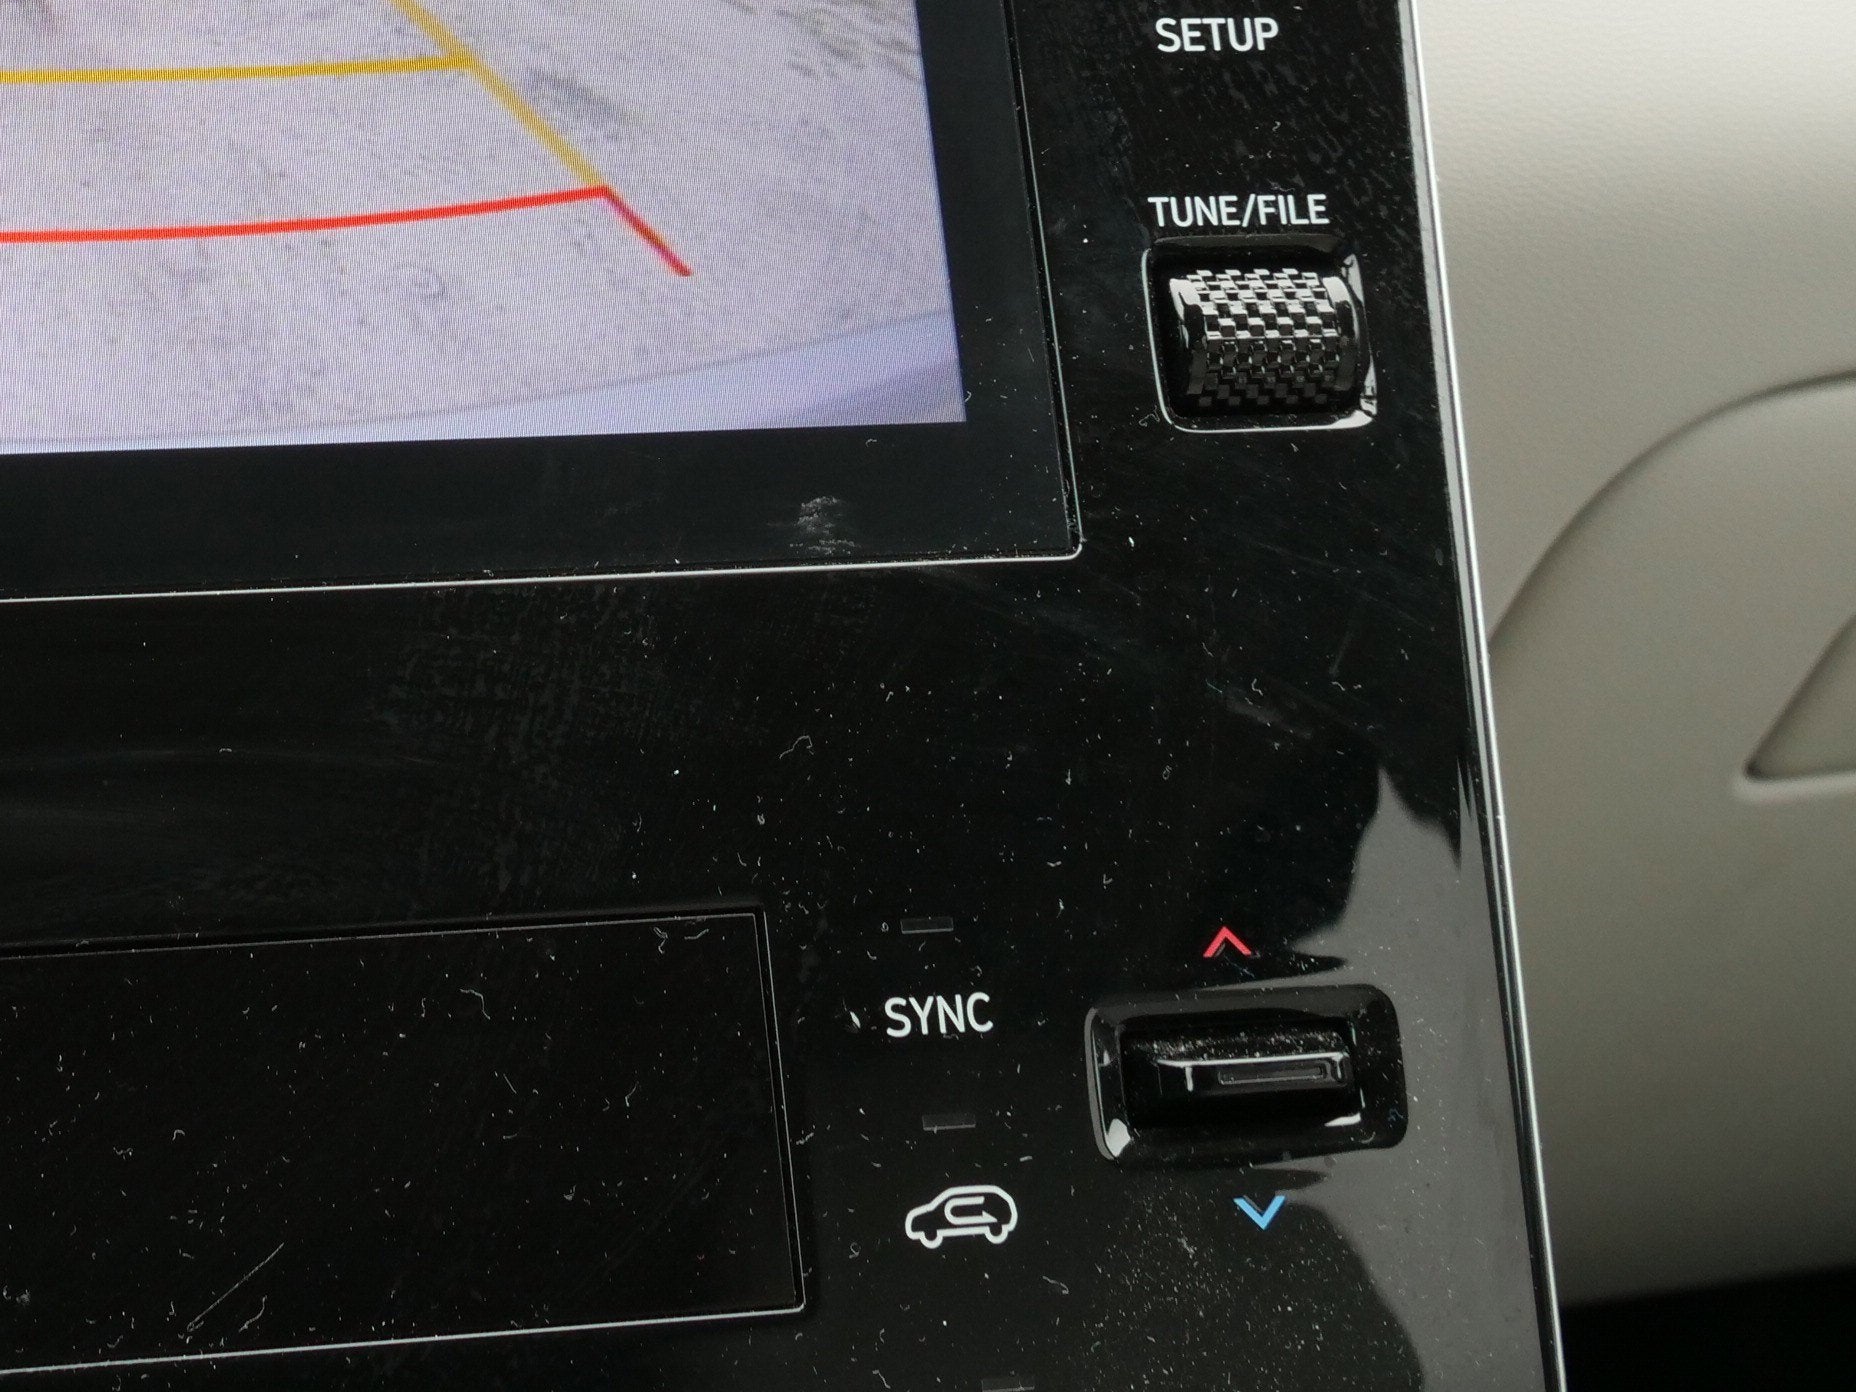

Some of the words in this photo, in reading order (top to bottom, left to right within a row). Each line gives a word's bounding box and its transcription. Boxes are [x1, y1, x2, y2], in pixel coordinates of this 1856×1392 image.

[1155, 16, 1279, 52] SETUP
[1147, 193, 1330, 228] TUNE/FILE
[884, 991, 994, 1038] SYNC
